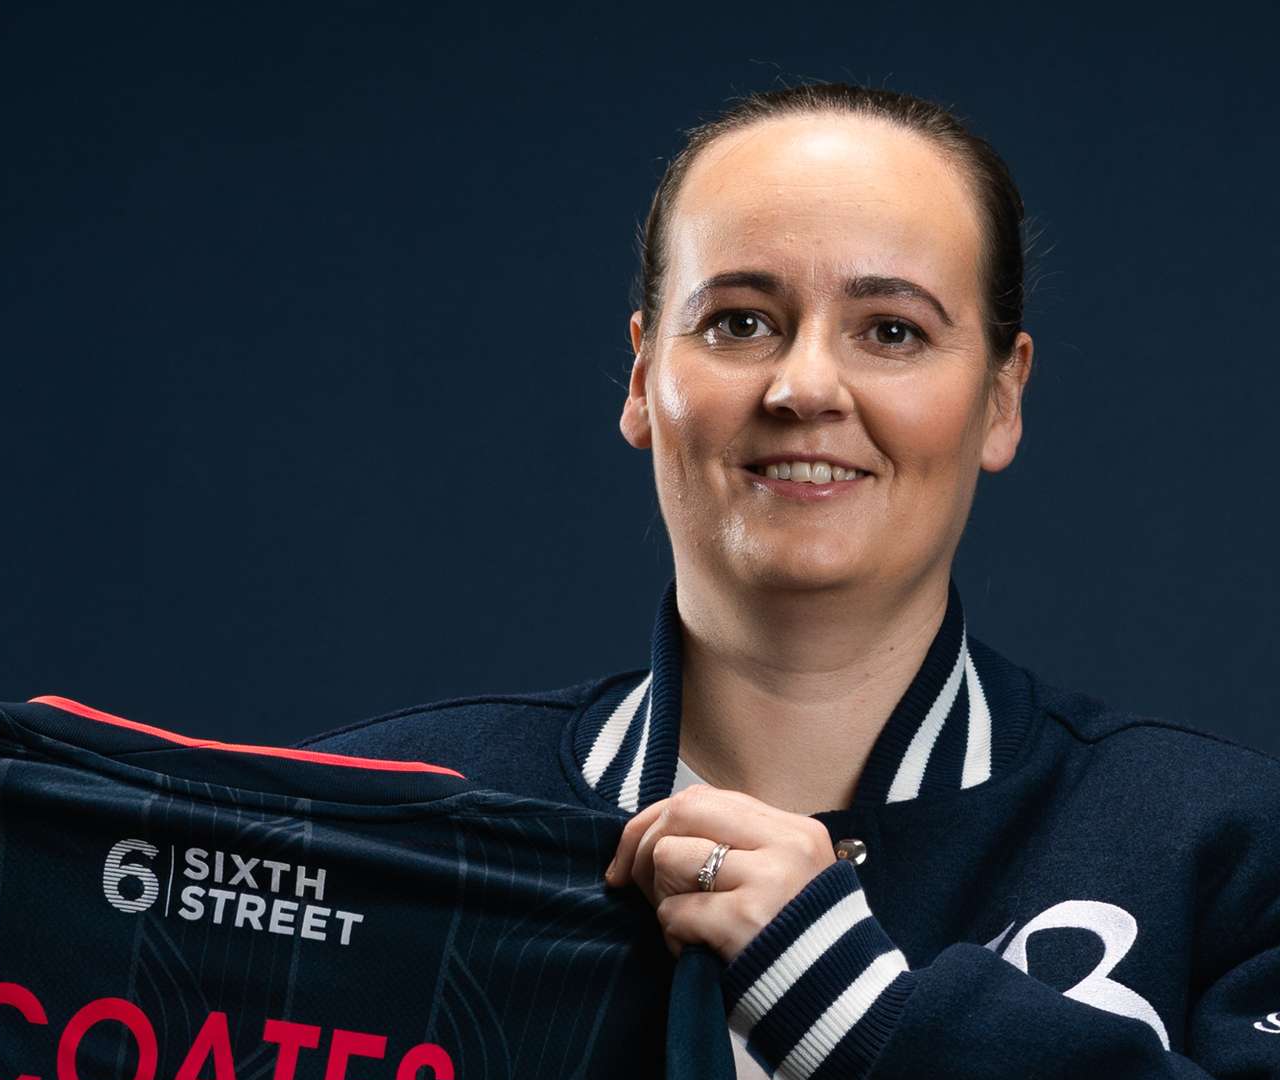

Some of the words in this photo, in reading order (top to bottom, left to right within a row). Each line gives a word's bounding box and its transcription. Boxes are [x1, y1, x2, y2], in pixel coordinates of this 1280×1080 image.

[102, 838, 160, 914] 6
[182, 847, 328, 901] SIXTH
[177, 885, 365, 946] STREET
